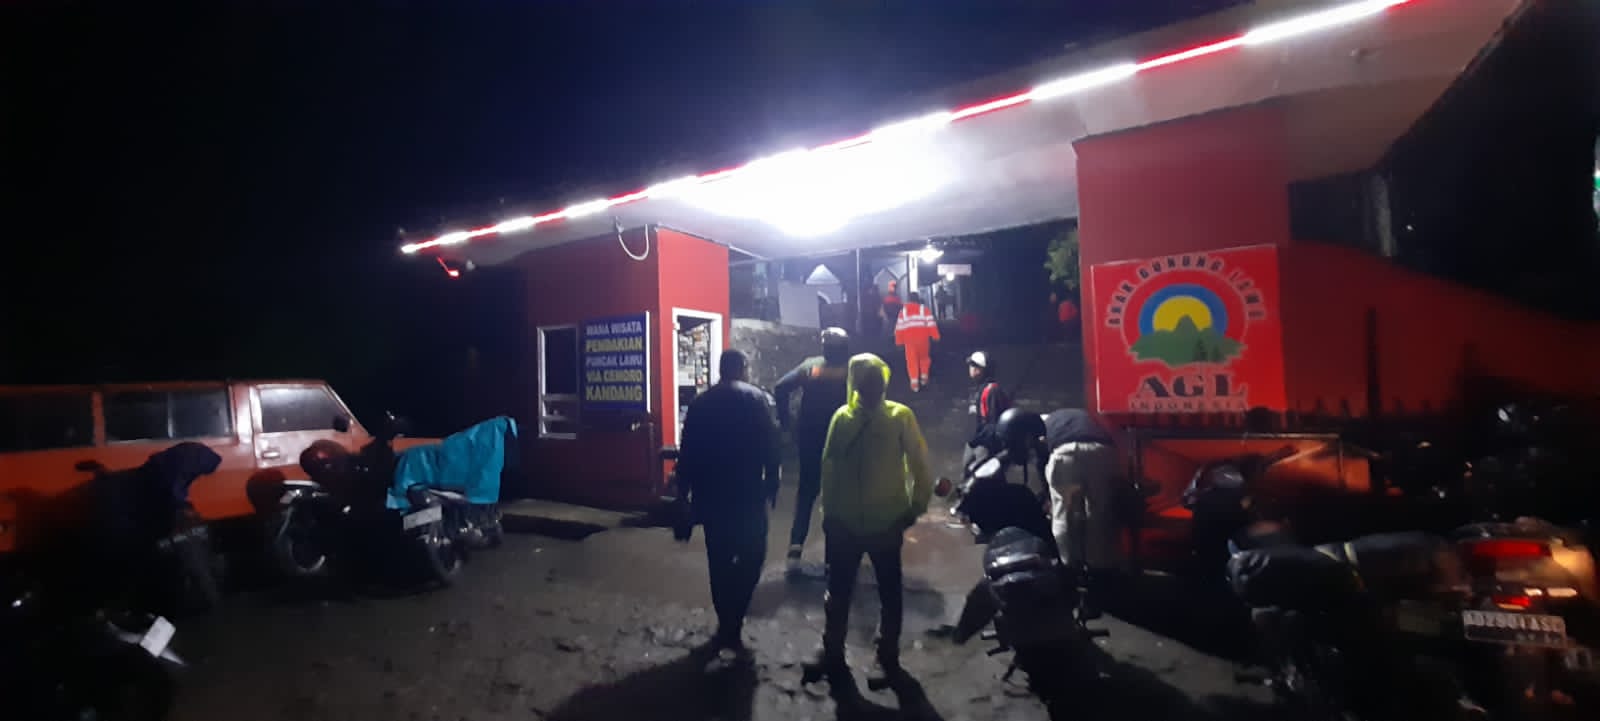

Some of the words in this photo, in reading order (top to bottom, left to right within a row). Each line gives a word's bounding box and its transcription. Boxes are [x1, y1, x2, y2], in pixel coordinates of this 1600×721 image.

[1139, 255, 1224, 280] GUNUNG
[586, 325, 610, 336] WANA
[611, 321, 642, 333] WISATA
[586, 337, 642, 352] PENDAKIAN
[586, 355, 618, 367] PUNCAK
[619, 354, 642, 366] LAWU
[586, 371, 602, 382] VIA
[604, 369, 642, 382] CEMORO
[586, 385, 642, 401] KANDANG
[1137, 374, 1246, 398] AGL
